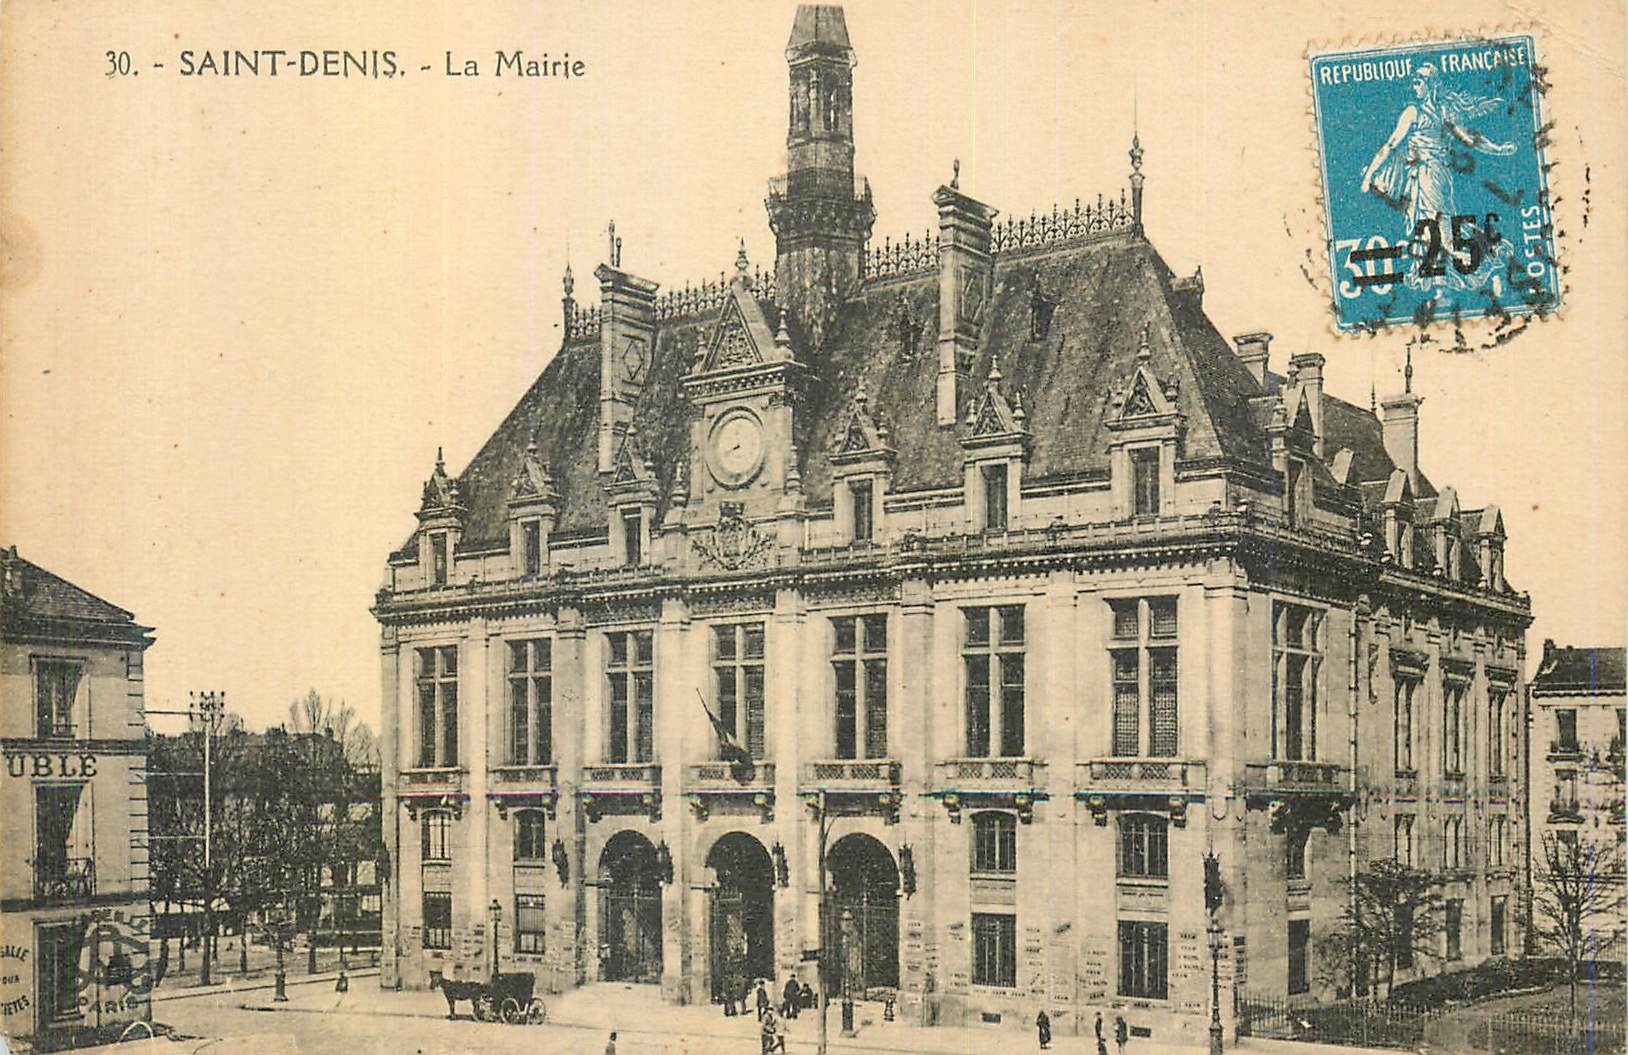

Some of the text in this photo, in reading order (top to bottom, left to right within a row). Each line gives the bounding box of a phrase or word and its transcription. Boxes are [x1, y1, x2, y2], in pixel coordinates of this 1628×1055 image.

[1319, 46, 1526, 85] REPUBLIQUE FRANÇAISE
[1521, 205, 1548, 294] OSTES
